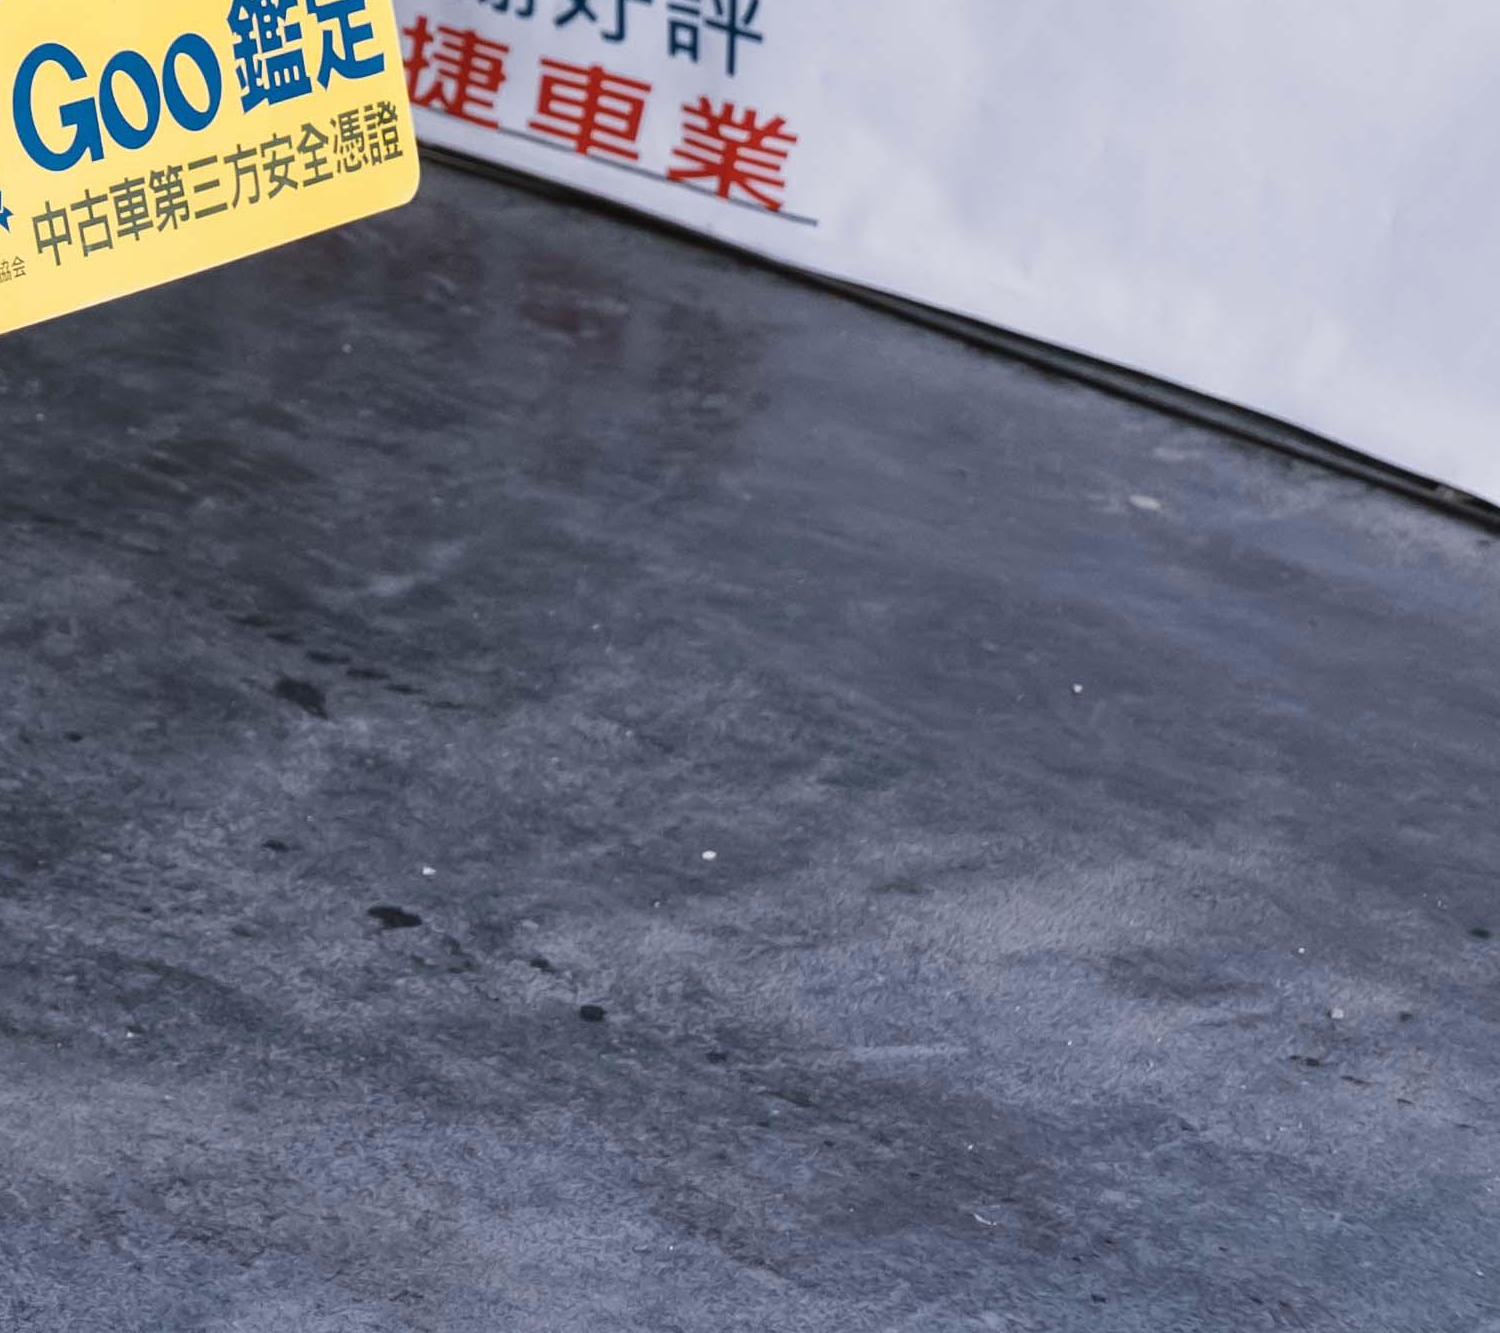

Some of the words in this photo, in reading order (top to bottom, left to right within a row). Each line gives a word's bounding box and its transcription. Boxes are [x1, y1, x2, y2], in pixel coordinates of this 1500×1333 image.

[31, 99, 404, 267] 中古車第三方安全憑證
